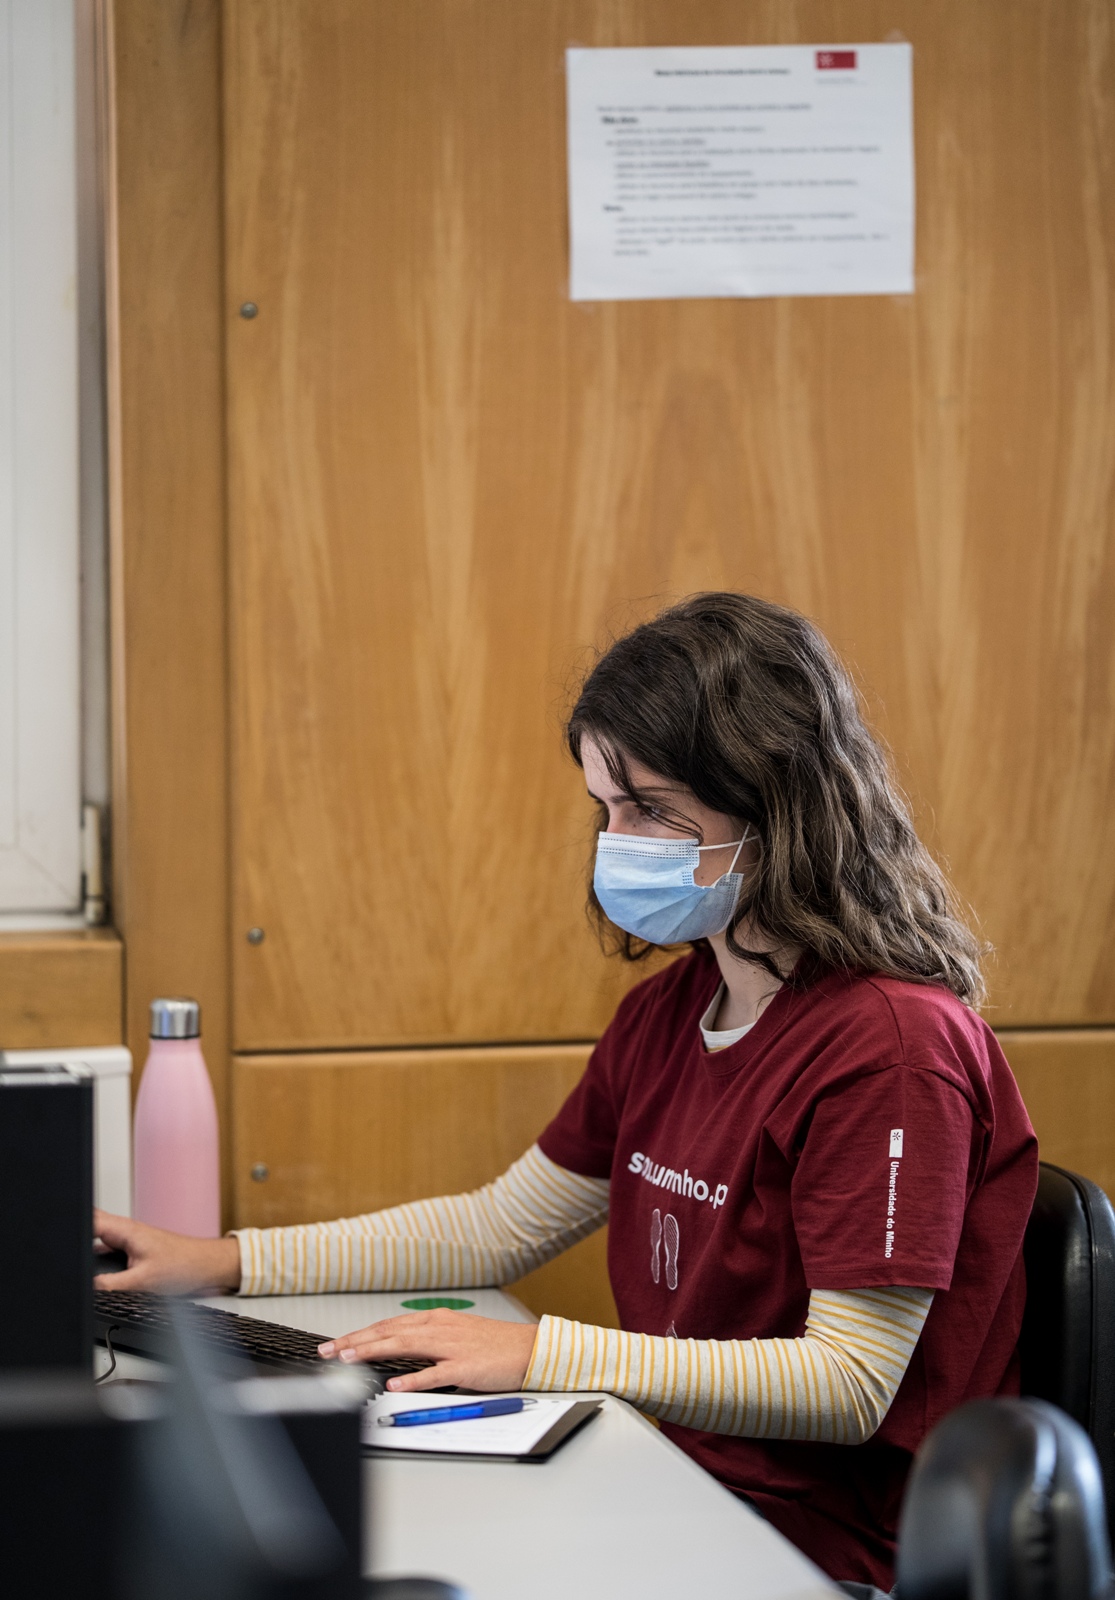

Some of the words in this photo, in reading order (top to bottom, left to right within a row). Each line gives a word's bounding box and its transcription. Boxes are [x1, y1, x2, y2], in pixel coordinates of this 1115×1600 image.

[887, 1161, 899, 1216] Universidade
[886, 1218, 895, 1229] do
[884, 1231, 894, 1259] Minho
